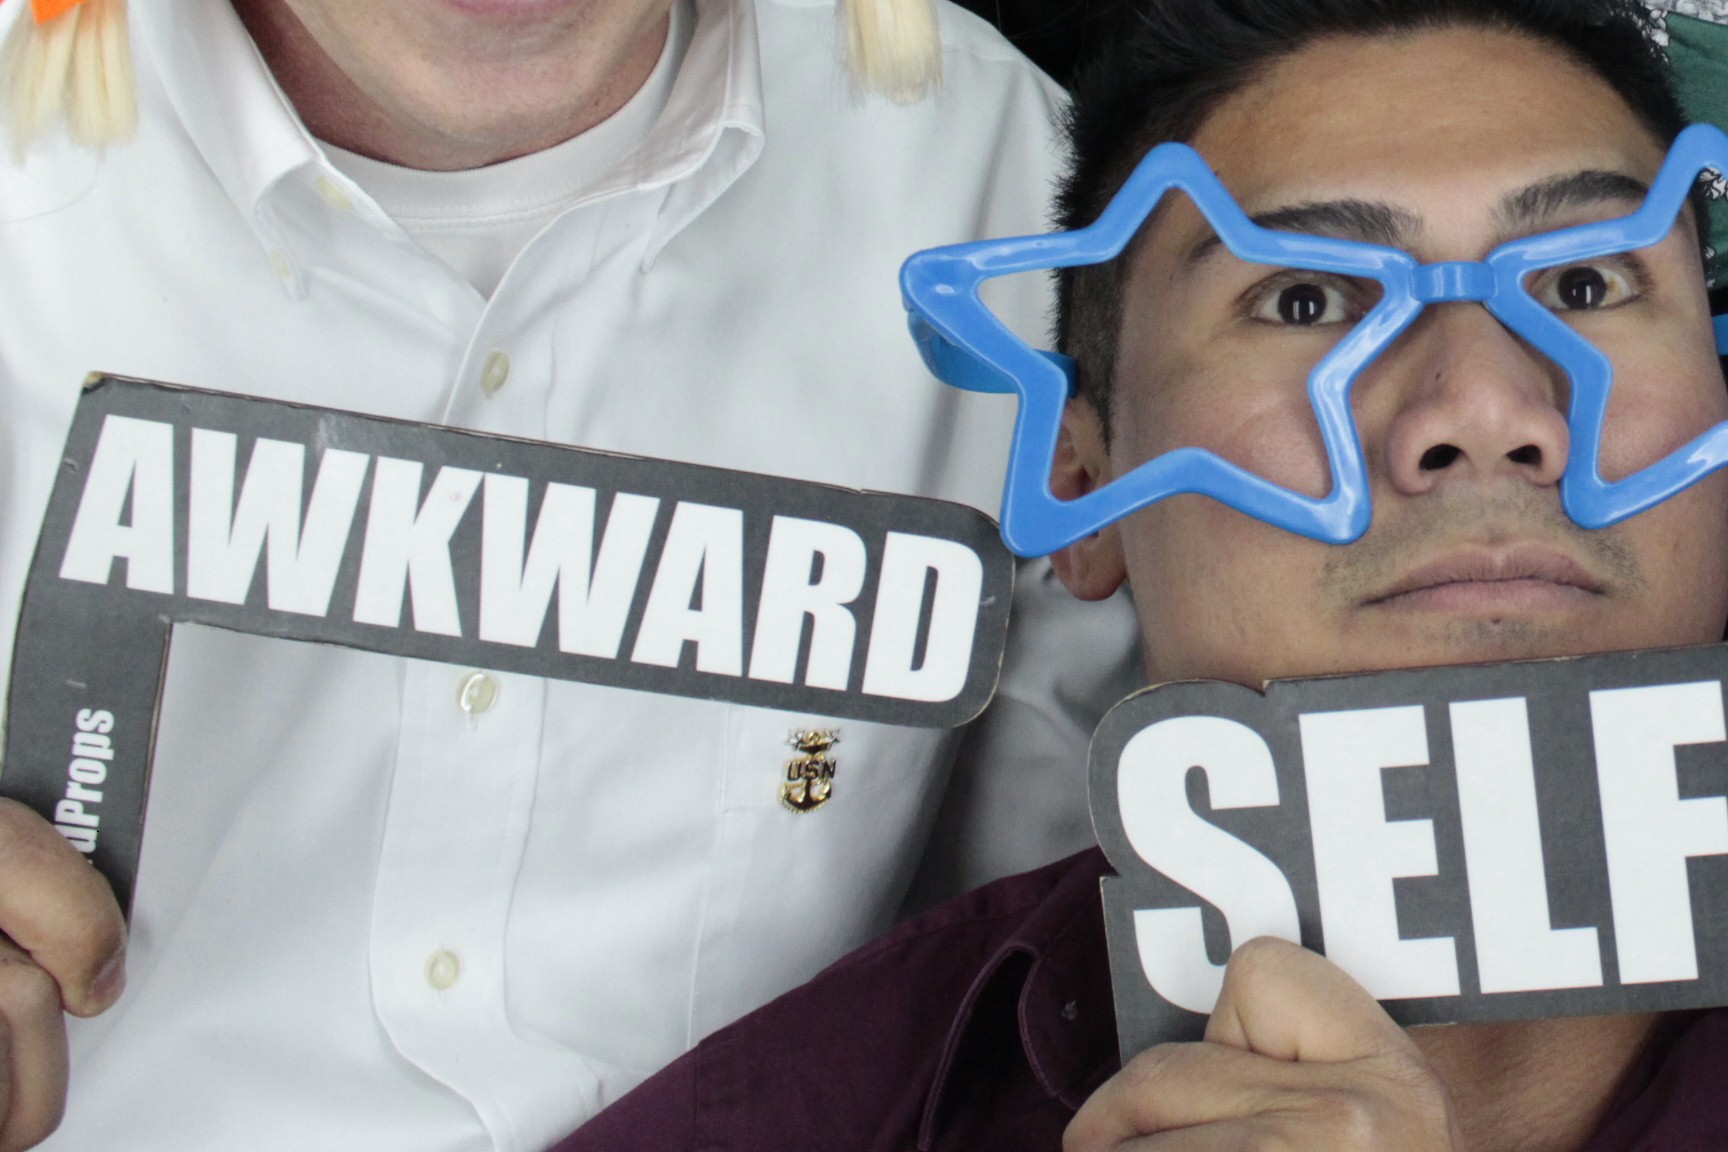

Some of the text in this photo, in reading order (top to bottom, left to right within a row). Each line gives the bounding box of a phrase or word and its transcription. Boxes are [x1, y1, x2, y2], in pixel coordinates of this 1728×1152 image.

[59, 413, 985, 704] AWKWARD
[55, 708, 114, 864] dProps
[786, 757, 837, 782] USN
